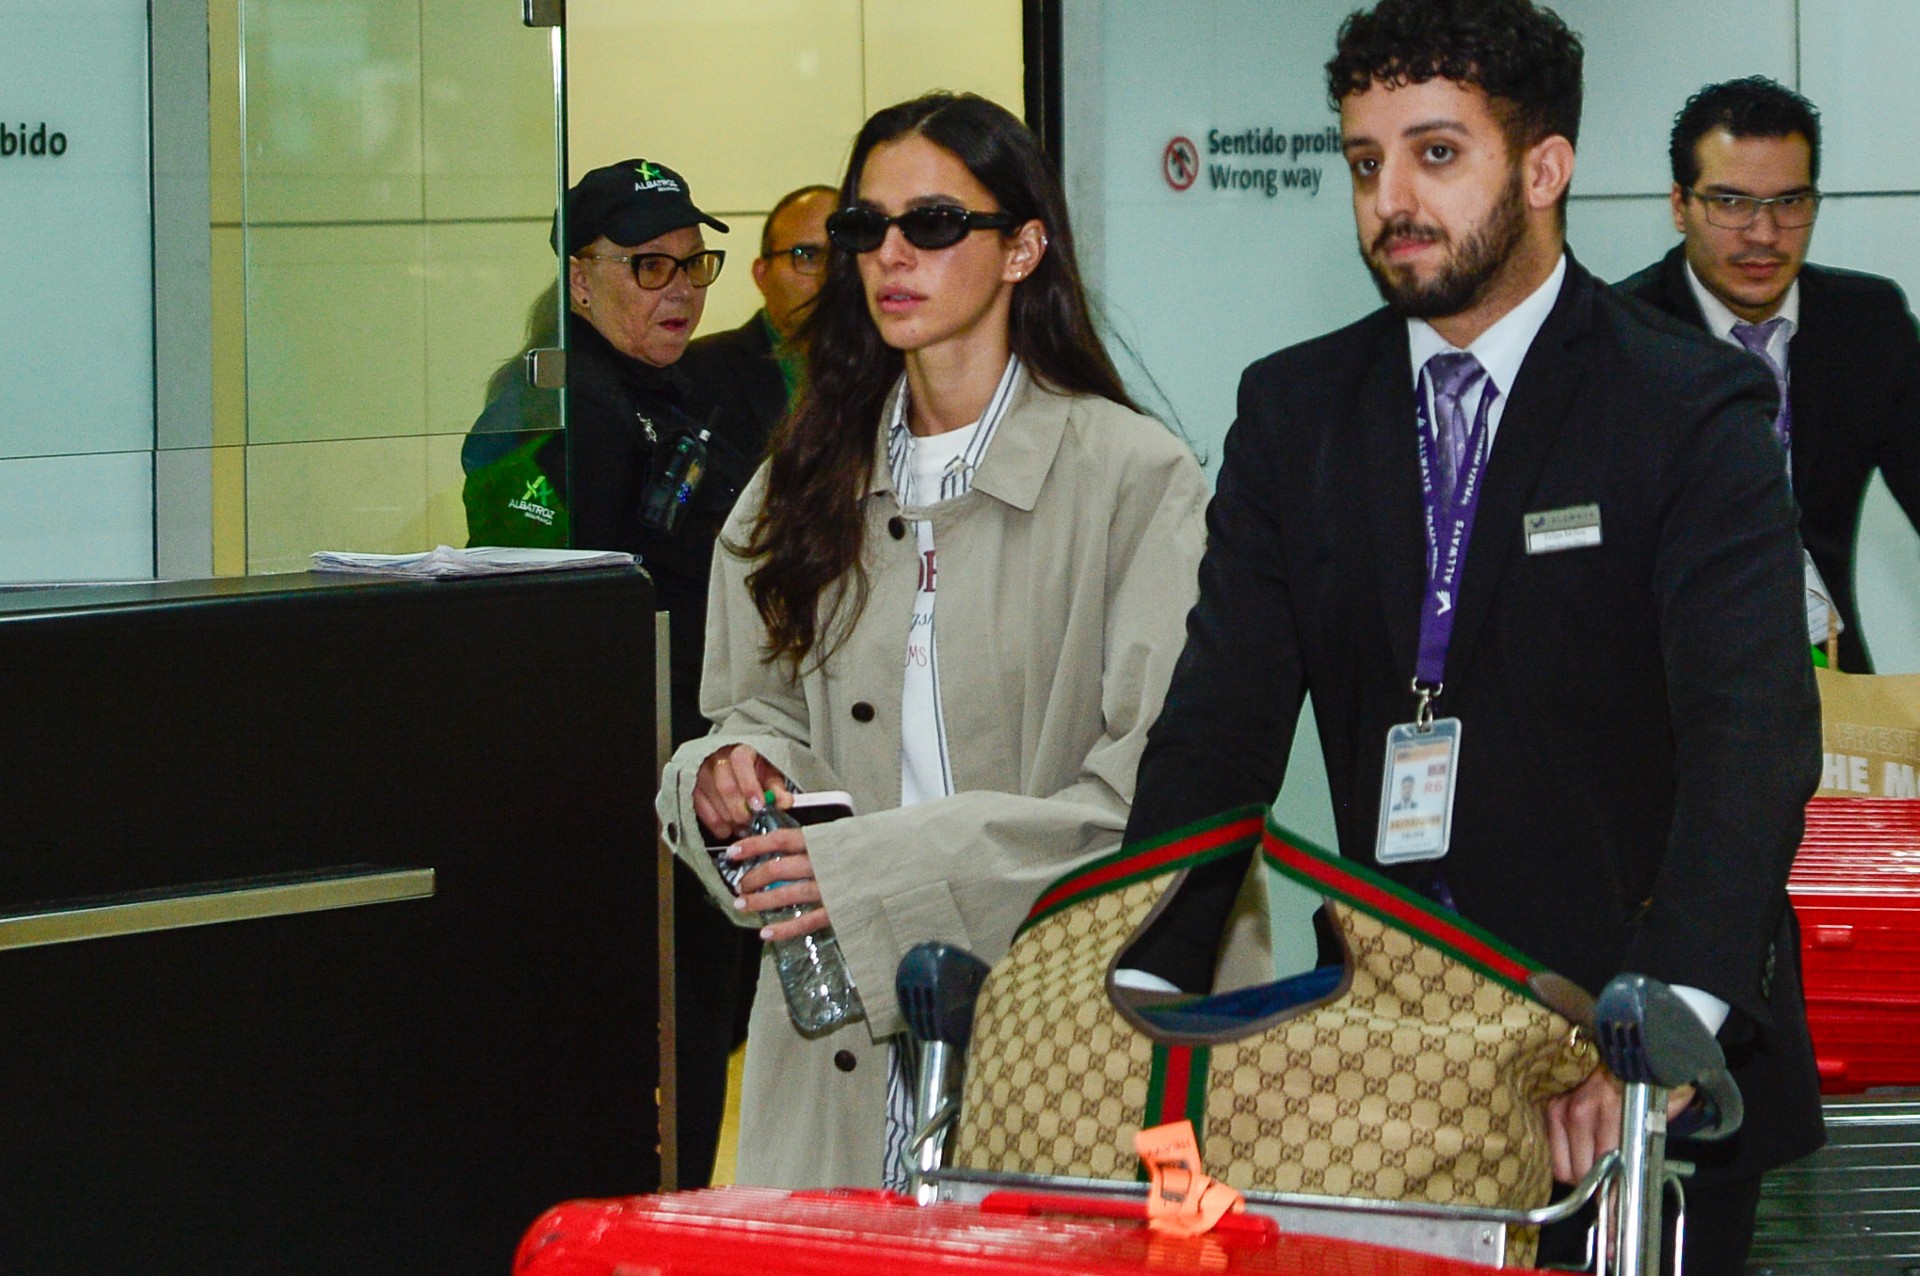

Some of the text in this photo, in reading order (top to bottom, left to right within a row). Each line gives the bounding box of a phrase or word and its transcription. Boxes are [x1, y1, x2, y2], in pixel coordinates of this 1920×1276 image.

[0, 121, 68, 156] bido
[1208, 127, 1288, 154] Sentido
[1209, 164, 1323, 198] Wrong way
[1418, 435, 1432, 493] ALLWAYS
[1465, 467, 1479, 497] PLAZA
[508, 498, 556, 520] ALBATROZ
[1444, 519, 1465, 584] ALLWAYS
[1885, 762, 1920, 799] M
